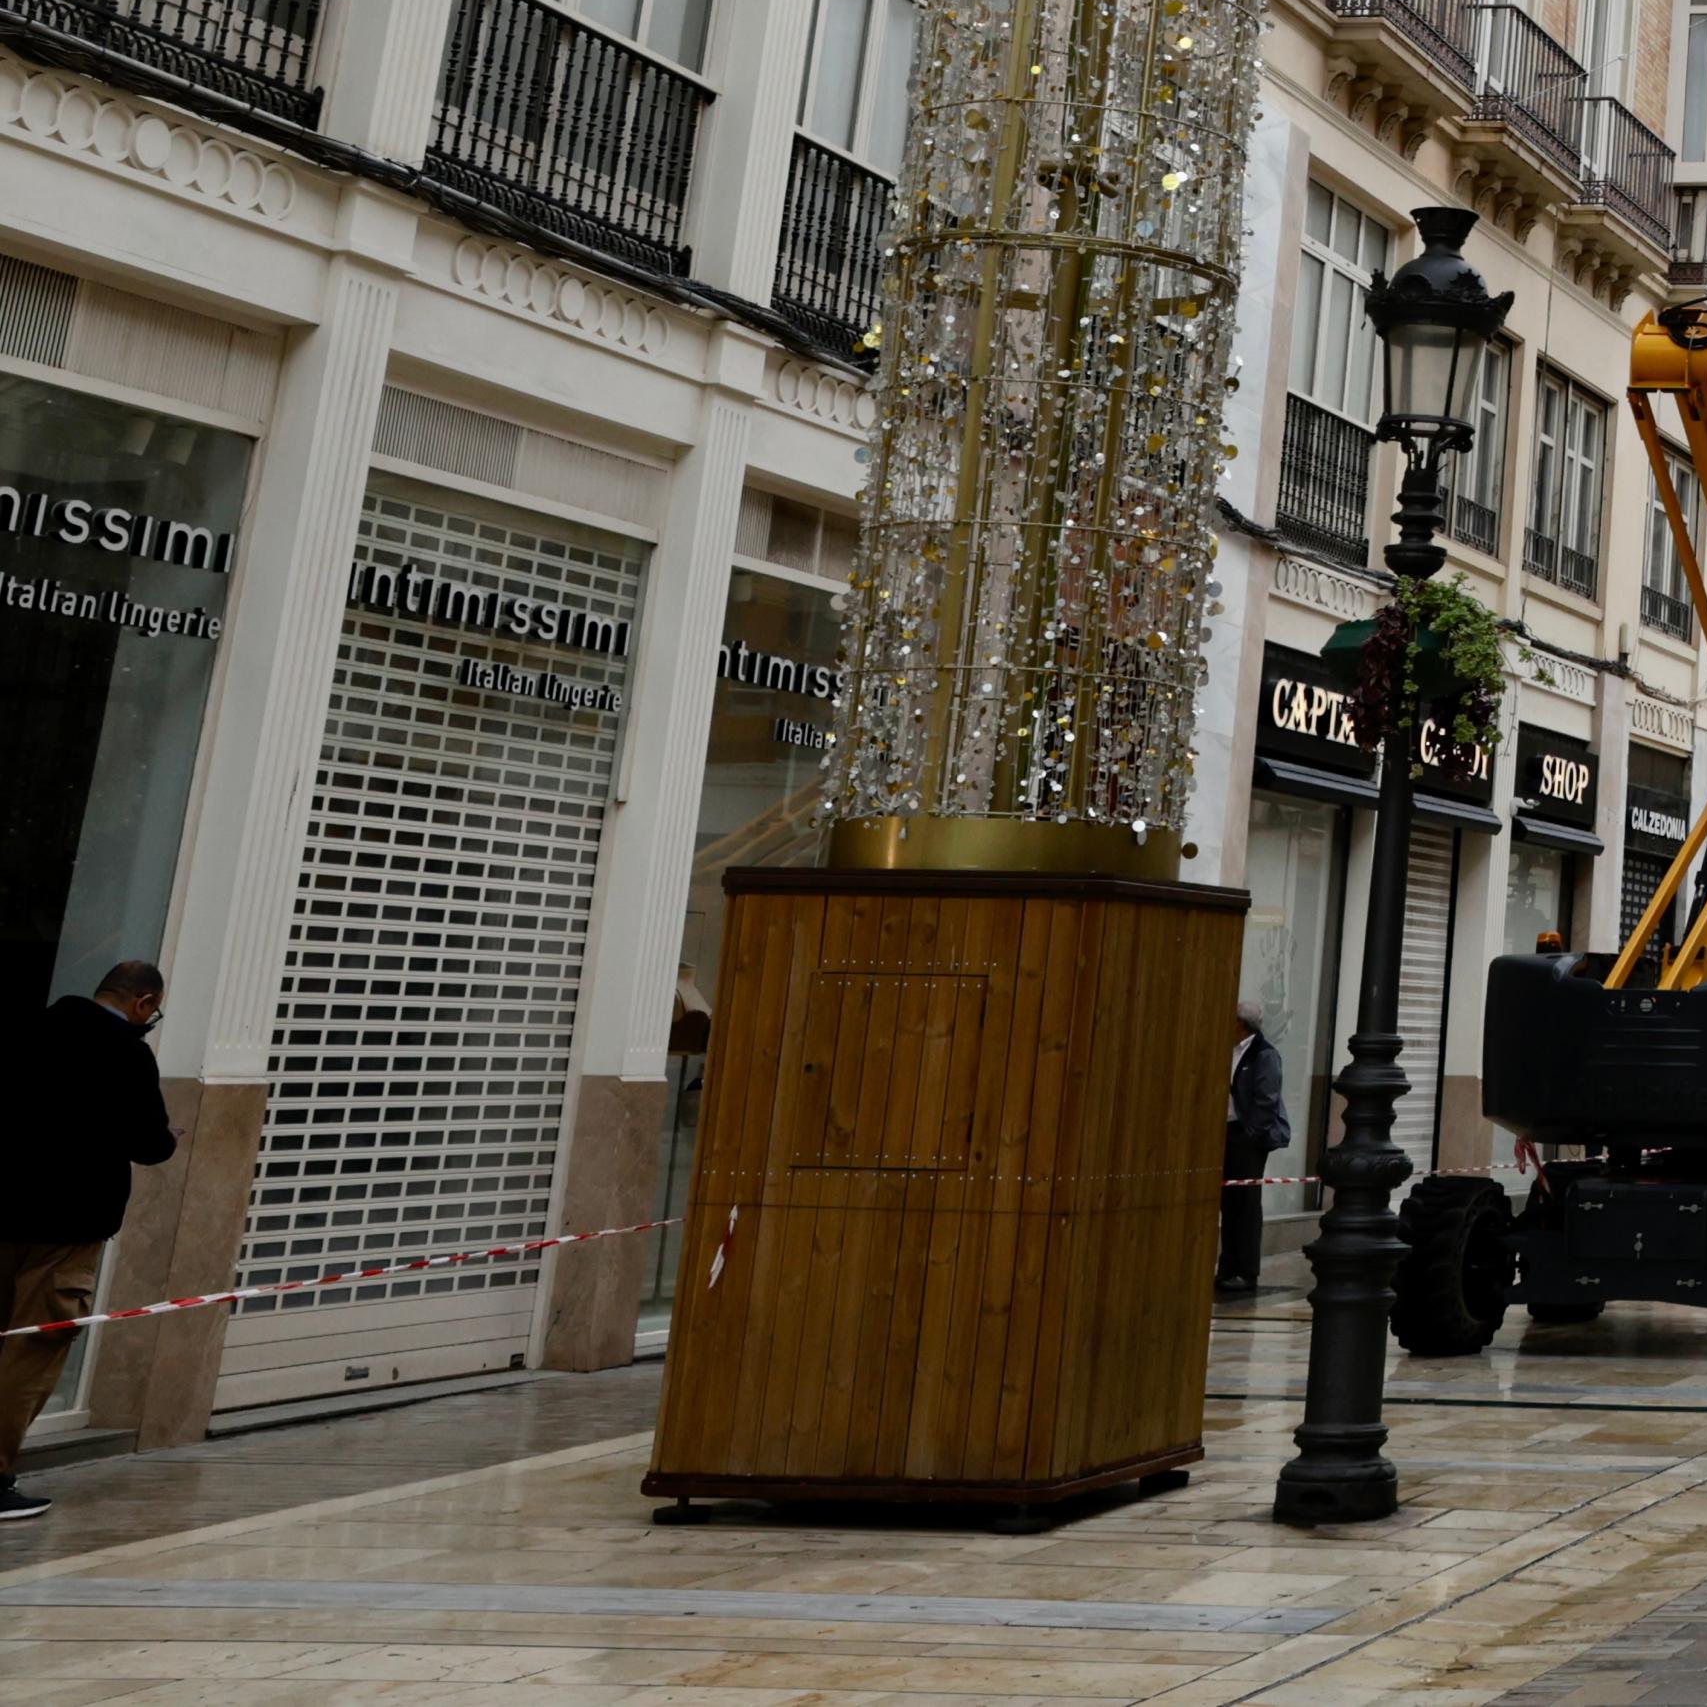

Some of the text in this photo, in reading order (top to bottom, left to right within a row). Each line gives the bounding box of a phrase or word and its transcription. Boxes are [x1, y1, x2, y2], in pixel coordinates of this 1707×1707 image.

[108, 591, 221, 639] lingerie
[350, 561, 631, 656] intimissimi
[467, 659, 622, 712] Italian lingerie
[1539, 755, 1589, 804] SHOP
[1631, 806, 1686, 841] CALZEDONIA
